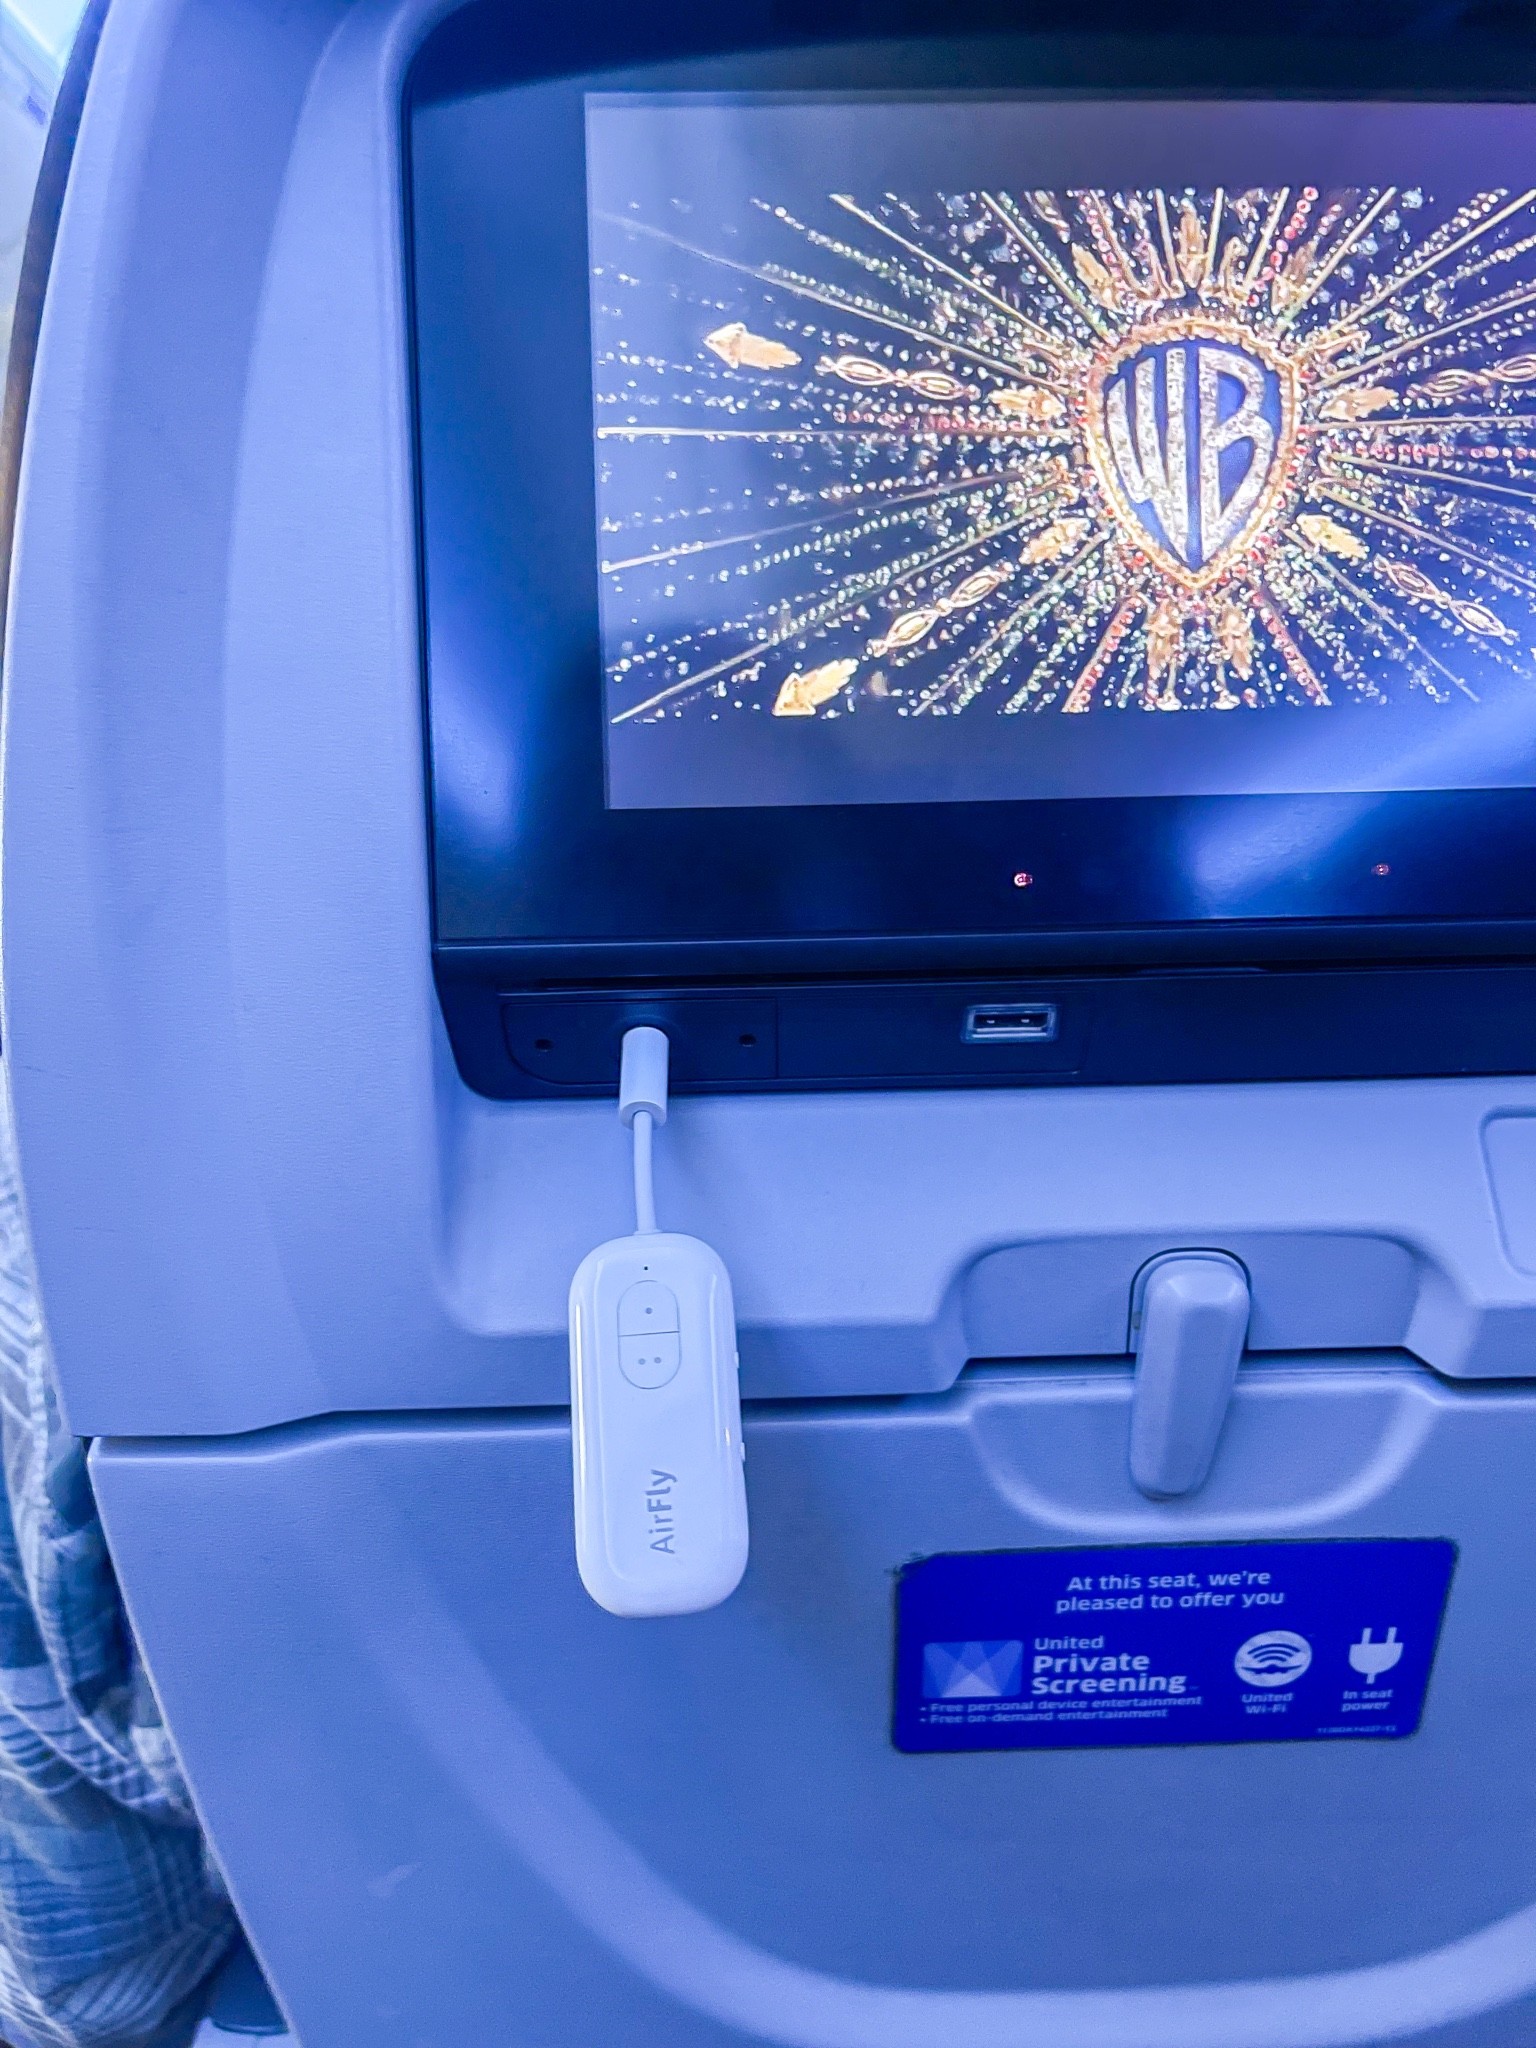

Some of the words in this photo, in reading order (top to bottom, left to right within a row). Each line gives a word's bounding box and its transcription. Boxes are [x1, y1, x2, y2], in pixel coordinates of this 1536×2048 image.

[1107, 347, 1273, 563] WB
[645, 1469, 678, 1554] AirFly
[1066, 1576, 1093, 1591] At
[1099, 1574, 1142, 1590] this
[1147, 1573, 1201, 1589] seat,
[1208, 1570, 1271, 1586] we're
[1055, 1594, 1144, 1614] pleased
[1151, 1594, 1174, 1609] to
[1179, 1591, 1236, 1608] offer
[1241, 1591, 1285, 1608] you
[1034, 1635, 1105, 1650] United
[1033, 1653, 1150, 1674] Private
[1031, 1673, 1187, 1695] Screening
[1241, 1692, 1294, 1703] United
[1342, 1690, 1358, 1699] In
[1361, 1689, 1394, 1699] seat
[930, 1703, 964, 1714] Free
[967, 1700, 1034, 1713] personal
[1037, 1699, 1088, 1711] device
[1091, 1695, 1202, 1709] entertainment
[1245, 1703, 1287, 1714] Wi-Fi
[1341, 1702, 1390, 1712] power
[929, 1714, 963, 1724] Free
[967, 1711, 1053, 1723] on-demand
[1057, 1708, 1168, 1721] entertainment
